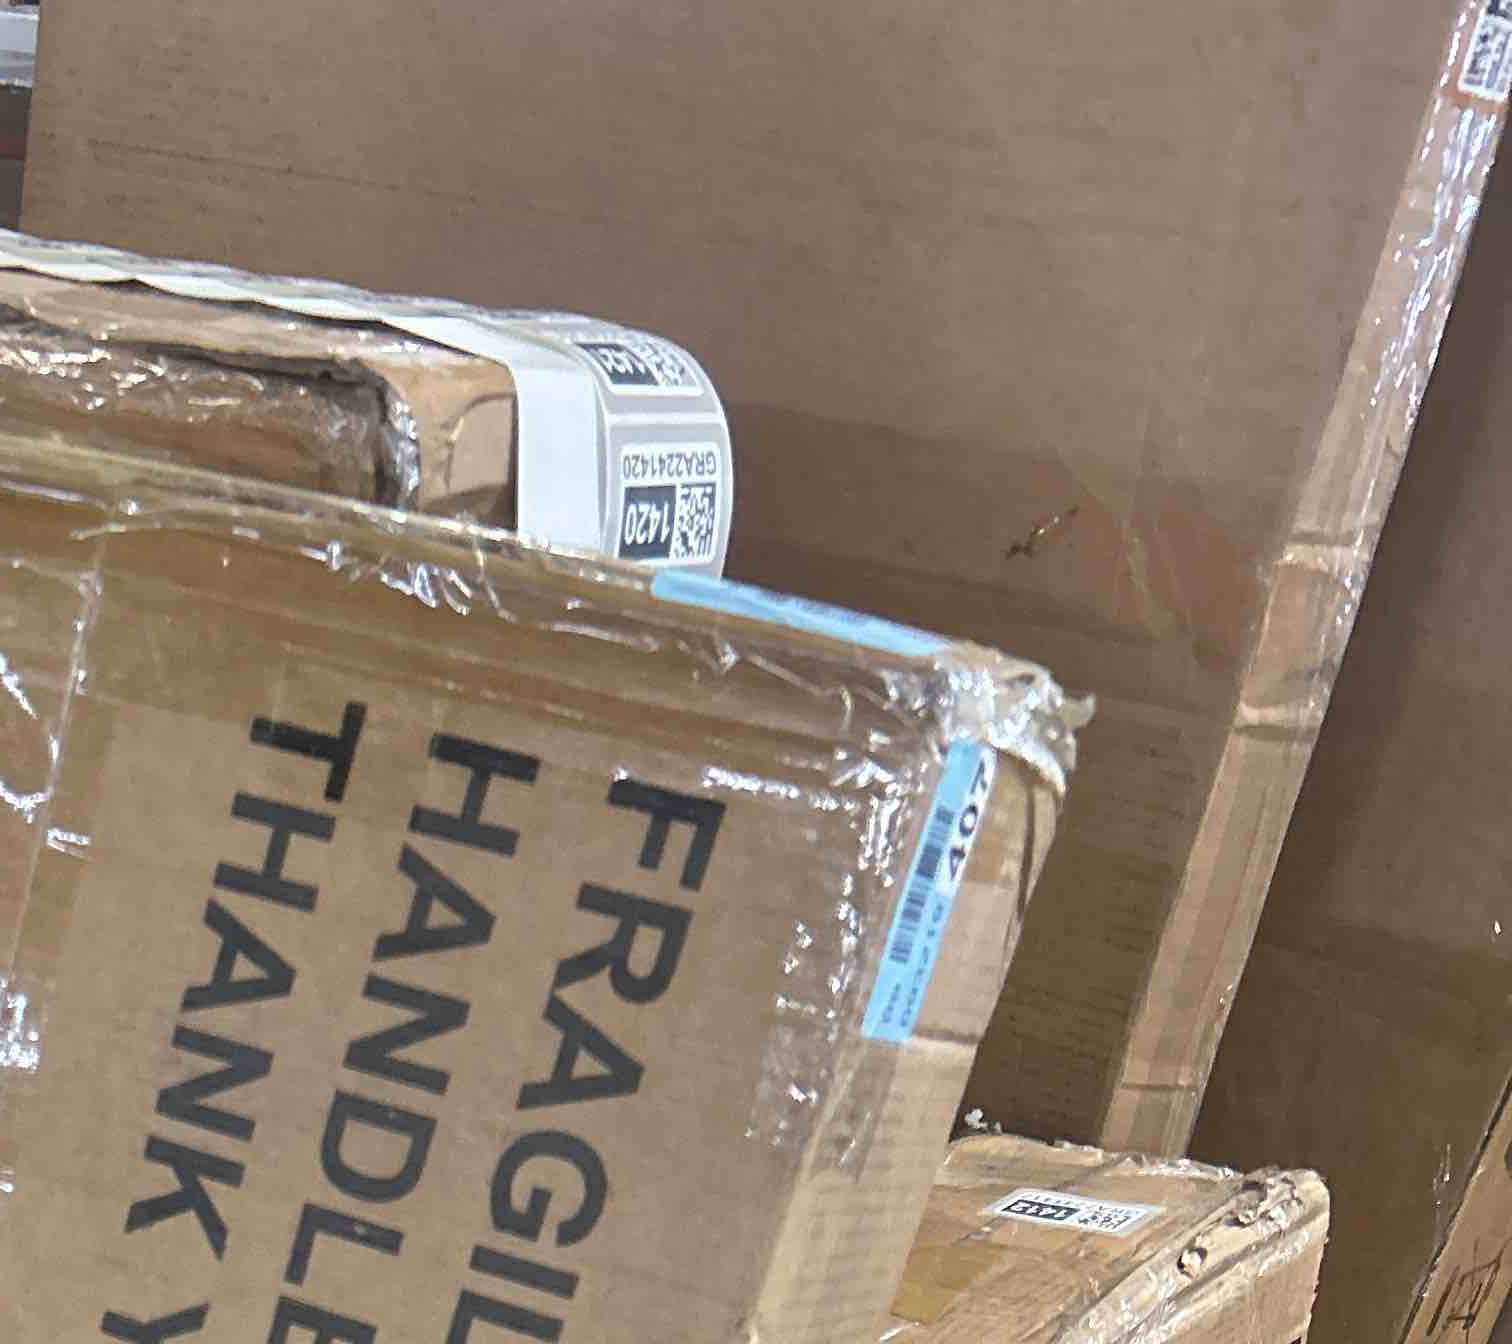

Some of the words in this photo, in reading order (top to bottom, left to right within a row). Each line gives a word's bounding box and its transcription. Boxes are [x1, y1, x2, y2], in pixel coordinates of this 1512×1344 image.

[623, 451, 717, 478] GRA2241420
[626, 501, 670, 545] 1420
[121, 699, 367, 1260] THANK
